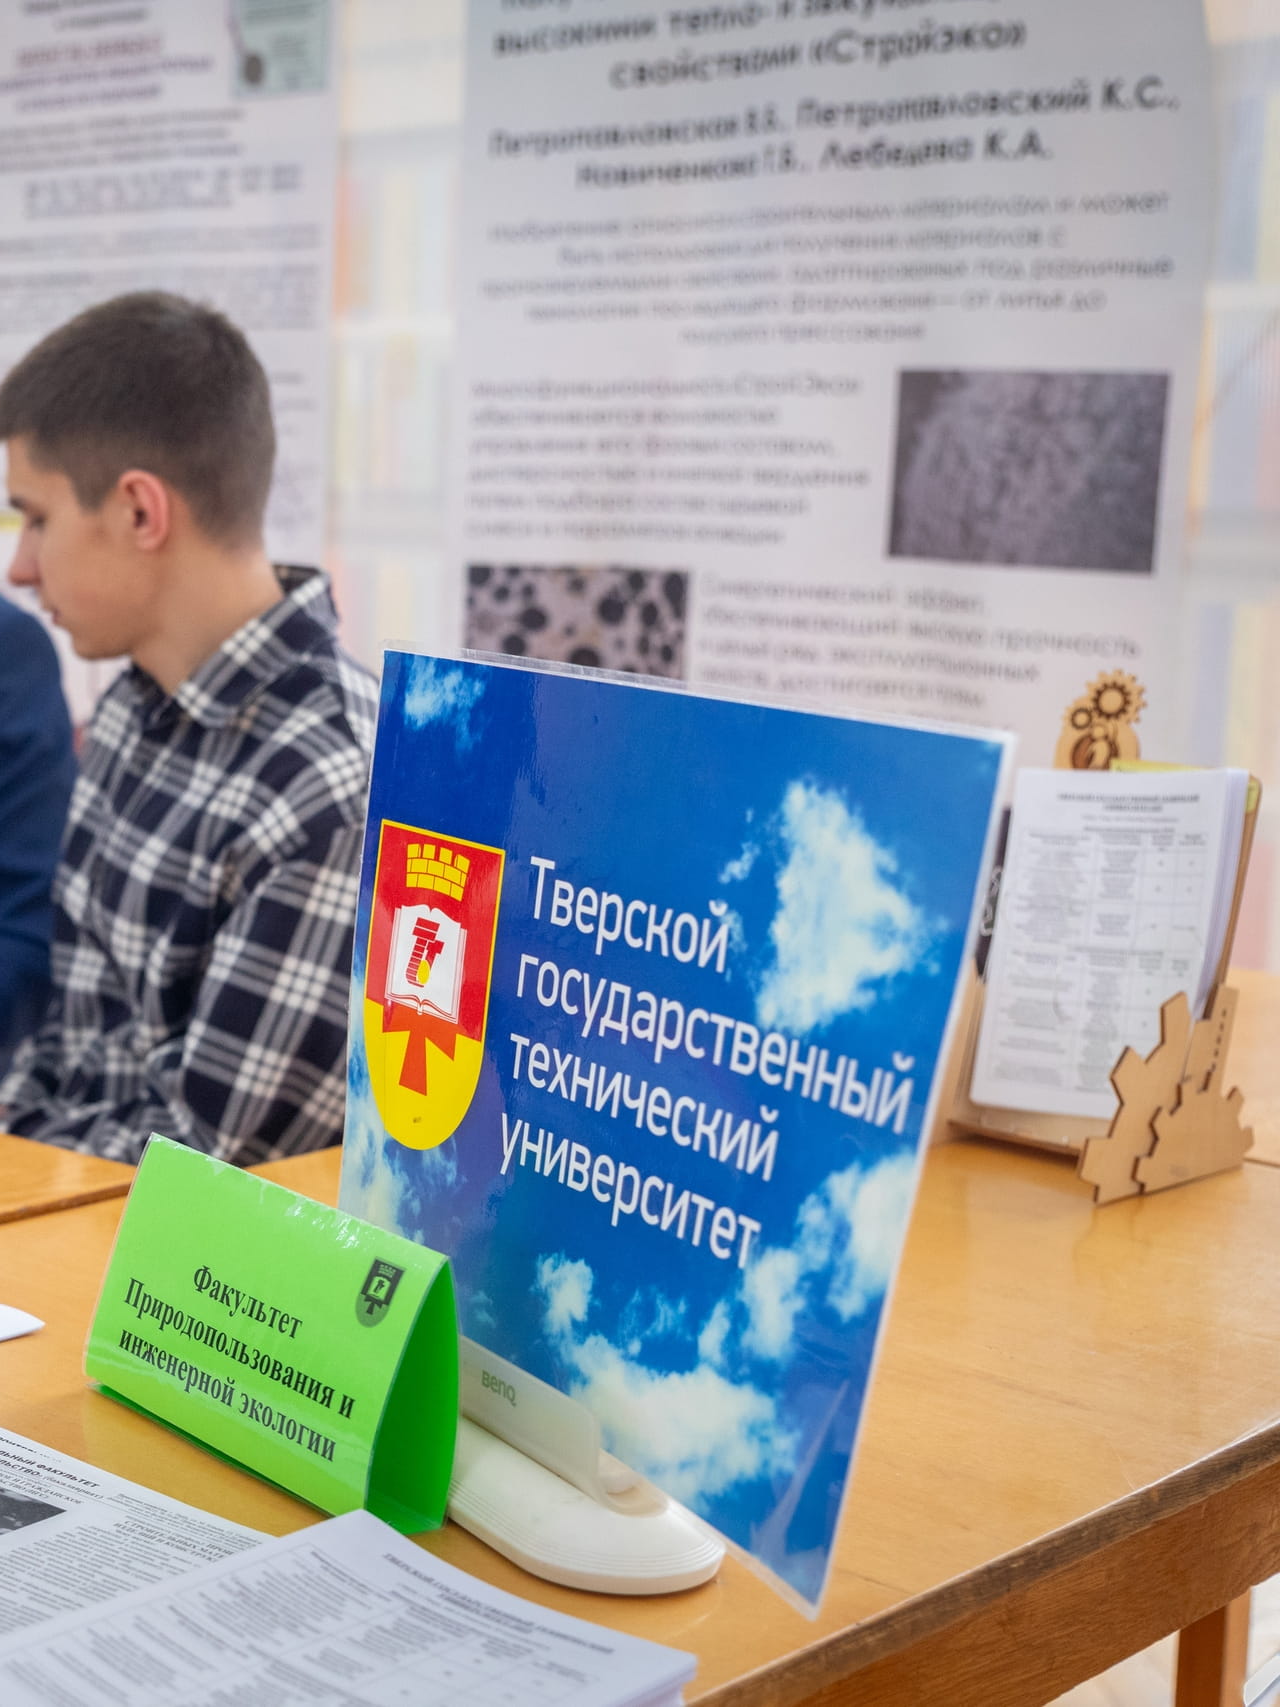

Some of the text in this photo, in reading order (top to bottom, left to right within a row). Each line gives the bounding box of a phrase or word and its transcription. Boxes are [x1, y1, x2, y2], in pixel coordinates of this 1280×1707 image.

[530, 855, 730, 974] Тверской
[510, 1032, 781, 1182] технический
[516, 951, 916, 1134] государственный
[500, 1113, 762, 1270] университет
[123, 1276, 356, 1420] Природопользования и
[193, 1263, 303, 1339] Факультет
[118, 1329, 337, 1463] инженерной экологии
[35, 1463, 101, 1489] ФАКУЛЬТЕТ
